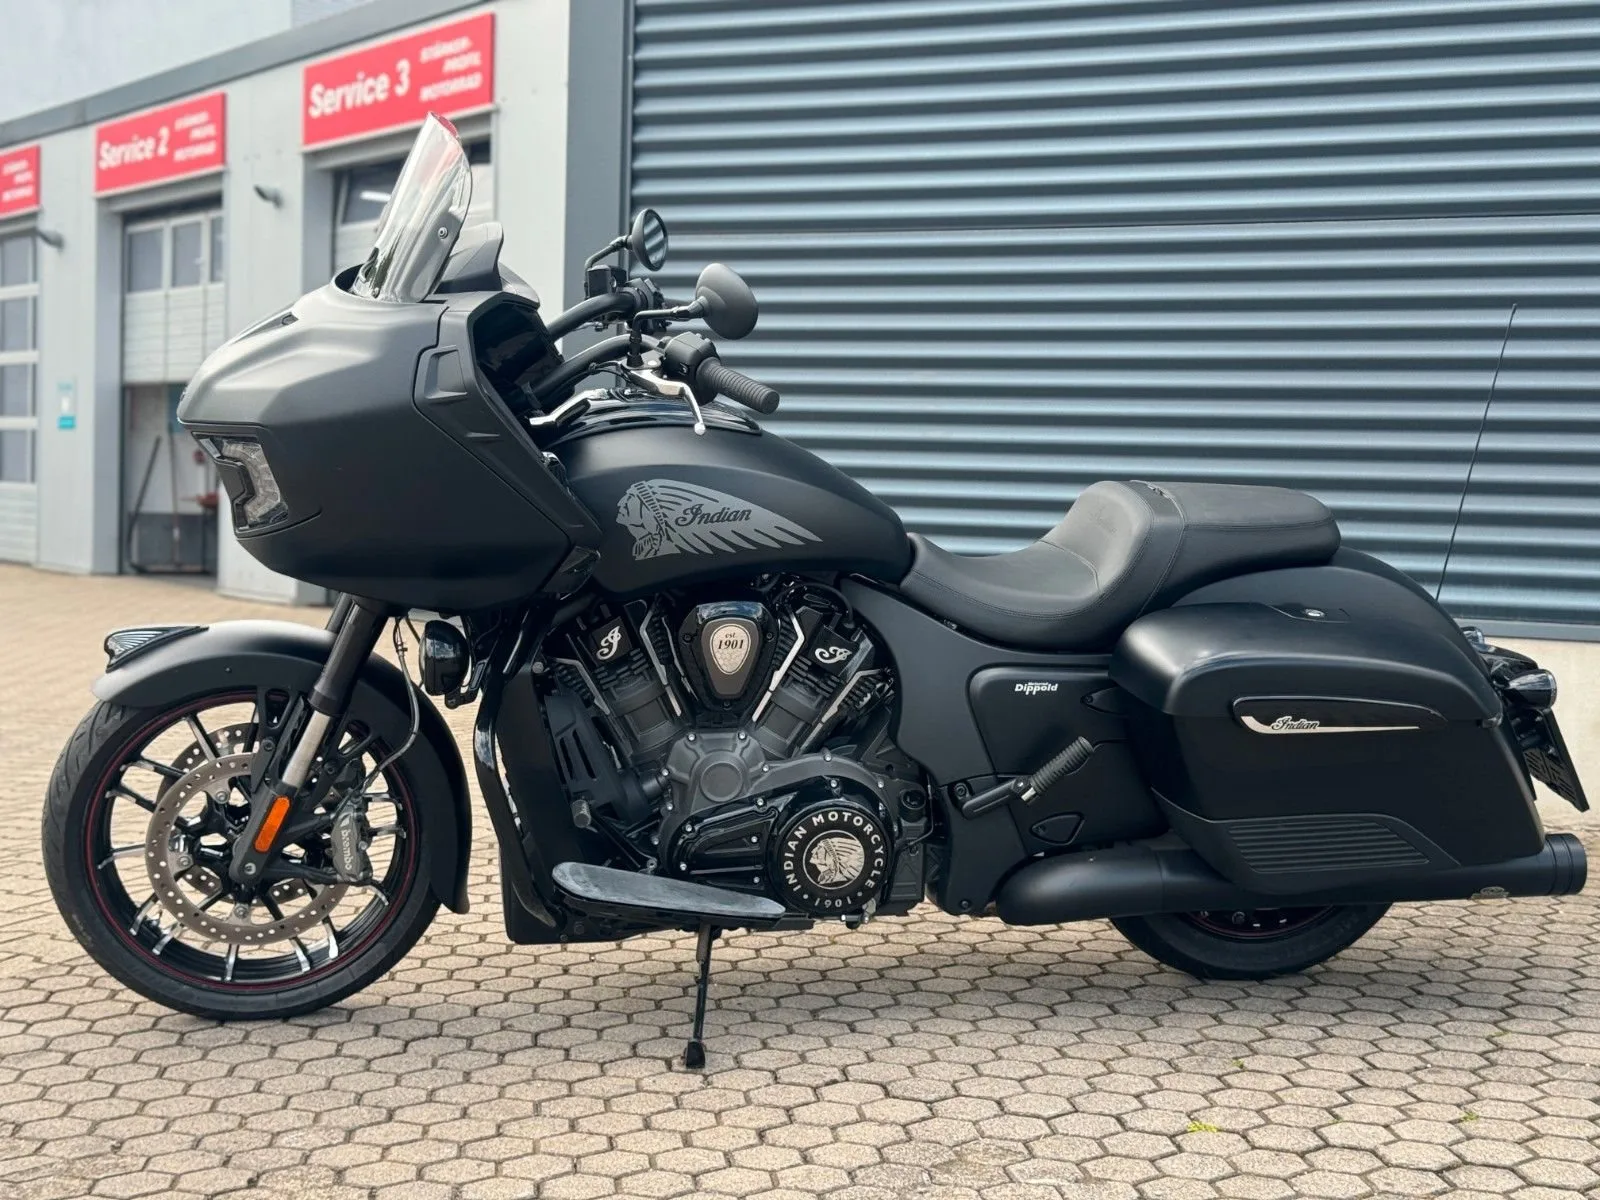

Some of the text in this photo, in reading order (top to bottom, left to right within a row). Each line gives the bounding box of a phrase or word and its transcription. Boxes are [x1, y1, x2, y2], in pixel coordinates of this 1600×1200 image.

[308, 58, 411, 119] Service 3
[98, 125, 170, 170] Service 2
[674, 503, 752, 527] Indian
[717, 639, 744, 650] 1901
[724, 631, 736, 639] est
[1014, 683, 1059, 696] Dippold
[1271, 715, 1320, 731] Indian
[341, 829, 354, 870] brembo
[783, 810, 885, 892] INDIAN MOTORCYCLE
[814, 895, 853, 909] 1901
